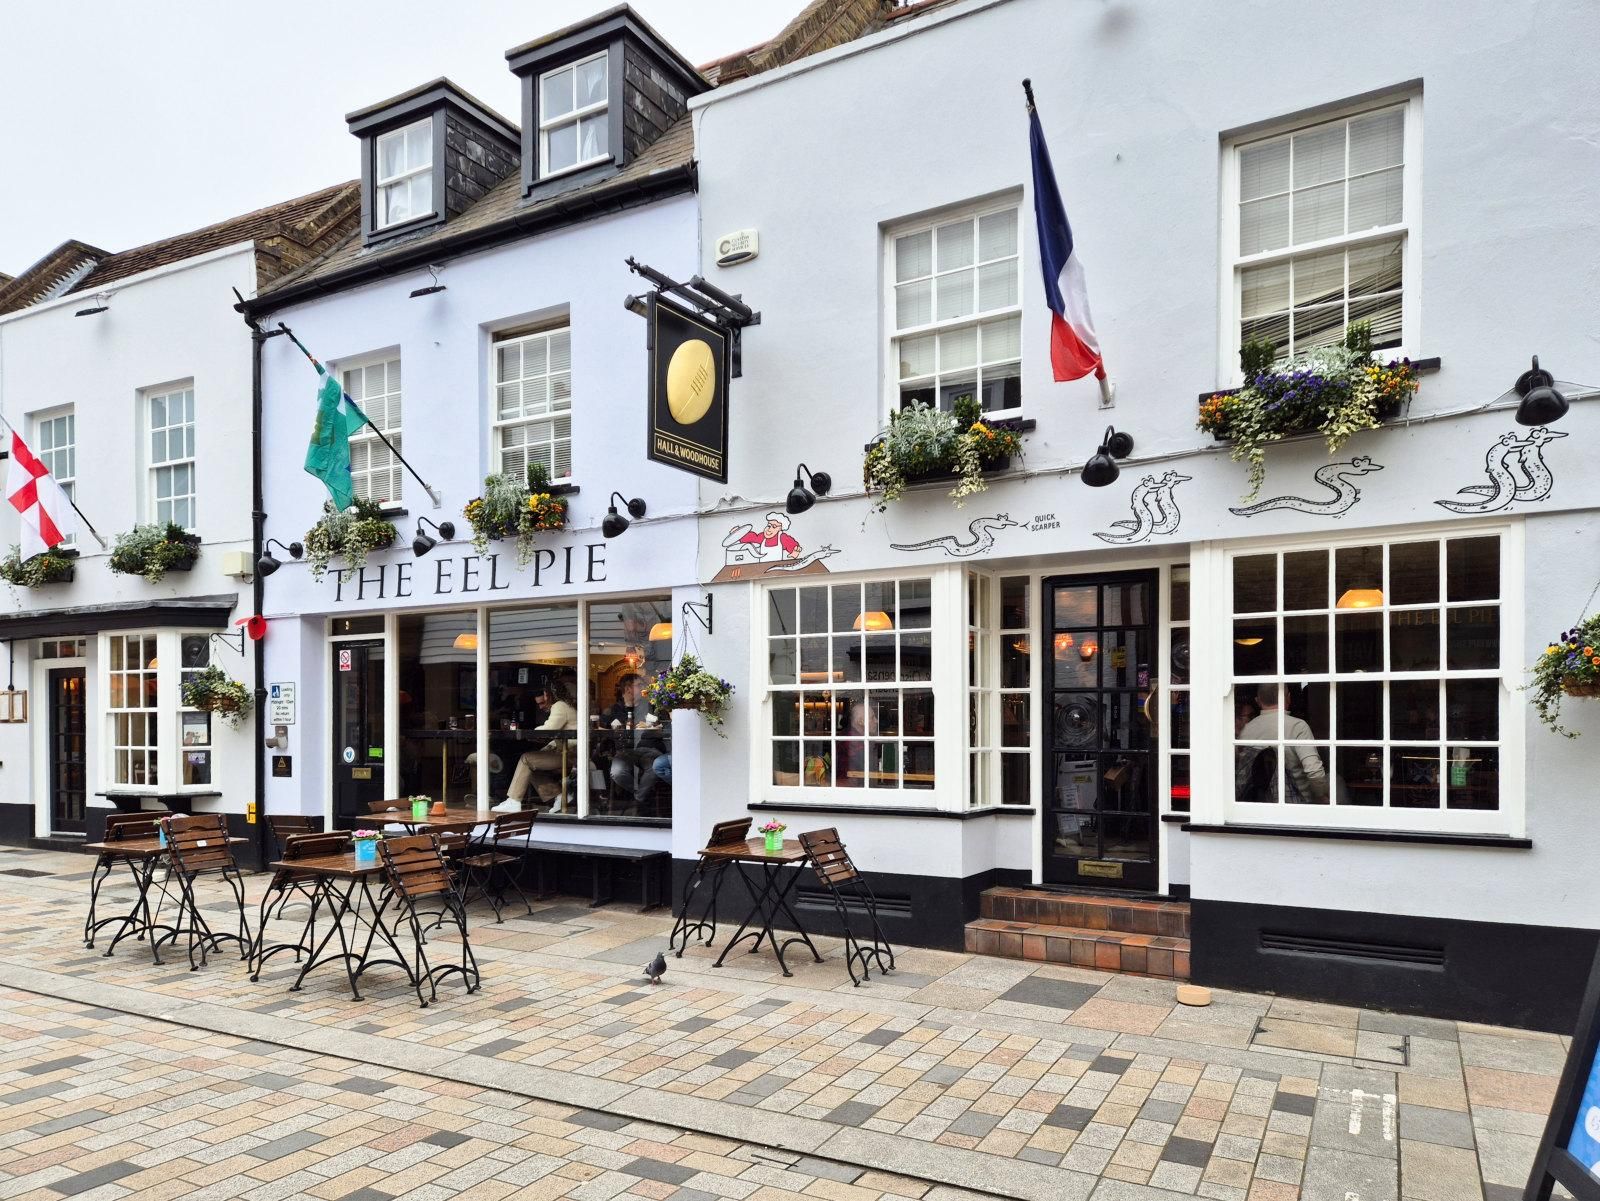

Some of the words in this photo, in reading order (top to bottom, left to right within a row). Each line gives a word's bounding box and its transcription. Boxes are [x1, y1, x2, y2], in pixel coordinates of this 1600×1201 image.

[657, 438, 674, 454] HALL
[681, 446, 719, 469] WOODHOUSE
[1031, 521, 1061, 532] SCARPER
[1034, 513, 1056, 523] QUICK
[328, 562, 413, 602] THE
[433, 554, 510, 595] EEL
[531, 543, 608, 586] PIE
